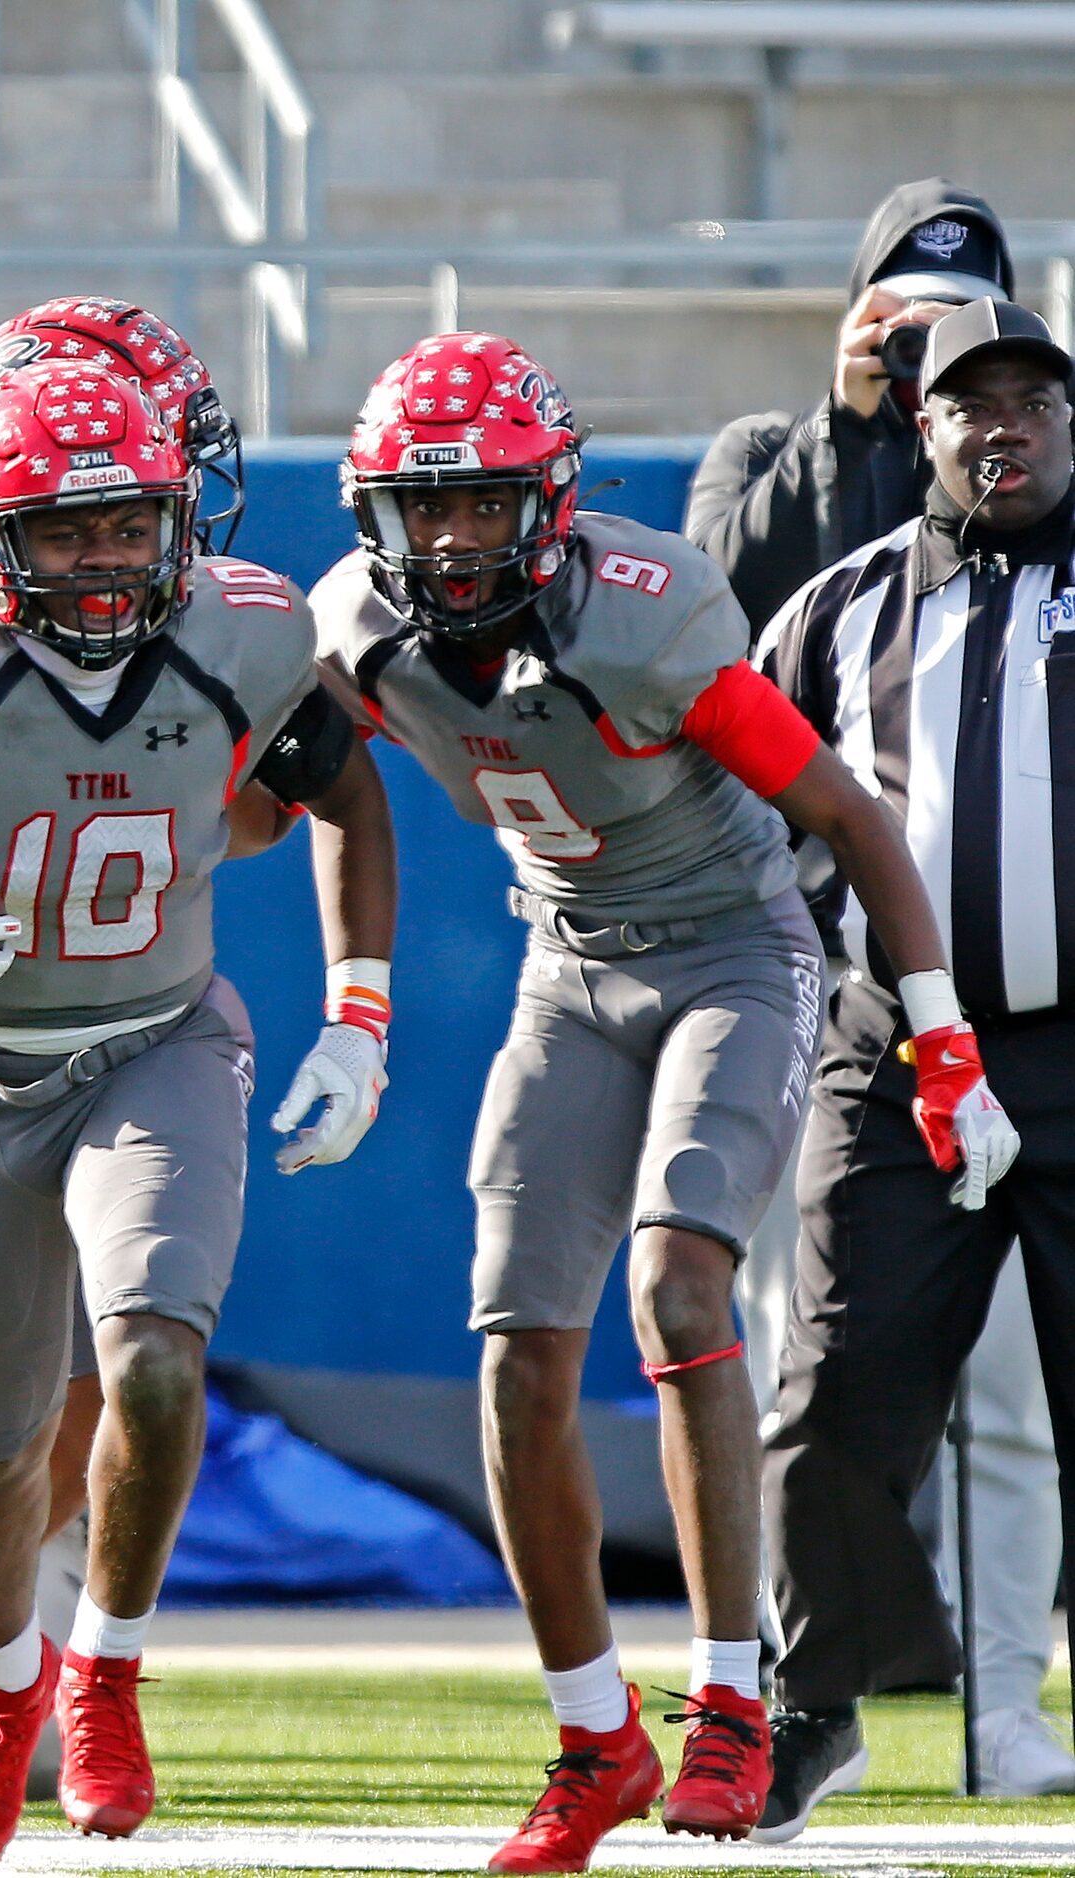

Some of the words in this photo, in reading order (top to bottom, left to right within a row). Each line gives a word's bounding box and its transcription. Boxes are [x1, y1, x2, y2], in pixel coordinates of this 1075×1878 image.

[70, 469, 129, 487] Riddell
[417, 449, 460, 462] TTHL
[205, 562, 291, 613] 10
[596, 550, 672, 598] 9
[460, 735, 519, 762] TTHL
[66, 773, 132, 800] TTHL
[471, 765, 606, 864] 9
[1, 808, 180, 961] 10
[792, 951, 821, 1054] CEDAR
[782, 1045, 810, 1119] HILL
